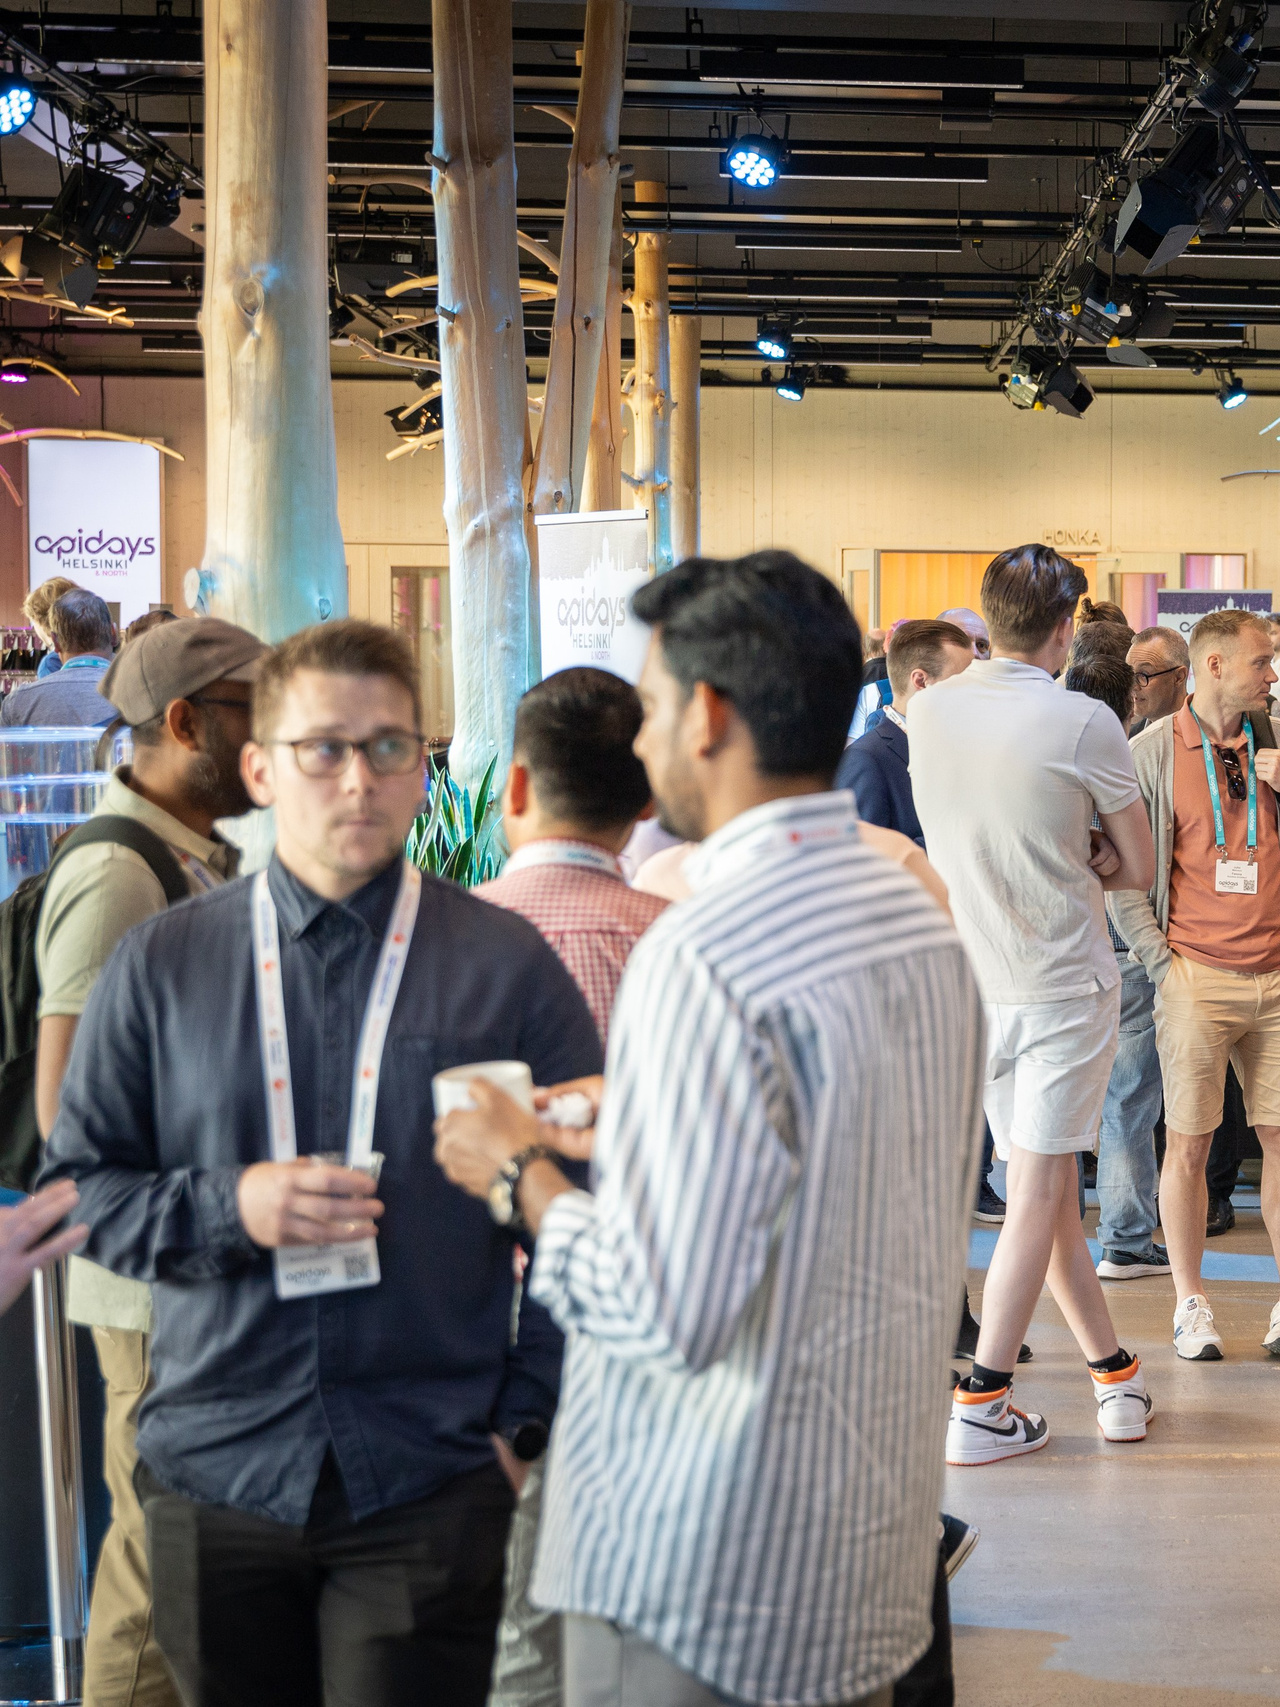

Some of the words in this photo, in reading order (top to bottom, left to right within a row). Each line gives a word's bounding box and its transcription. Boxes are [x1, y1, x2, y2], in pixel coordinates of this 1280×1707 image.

[34, 528, 156, 562] apidays
[1043, 528, 1102, 546] HONKA
[62, 559, 128, 569] HELSINKI
[557, 586, 626, 638] apidays
[572, 633, 611, 649] HELSINKI
